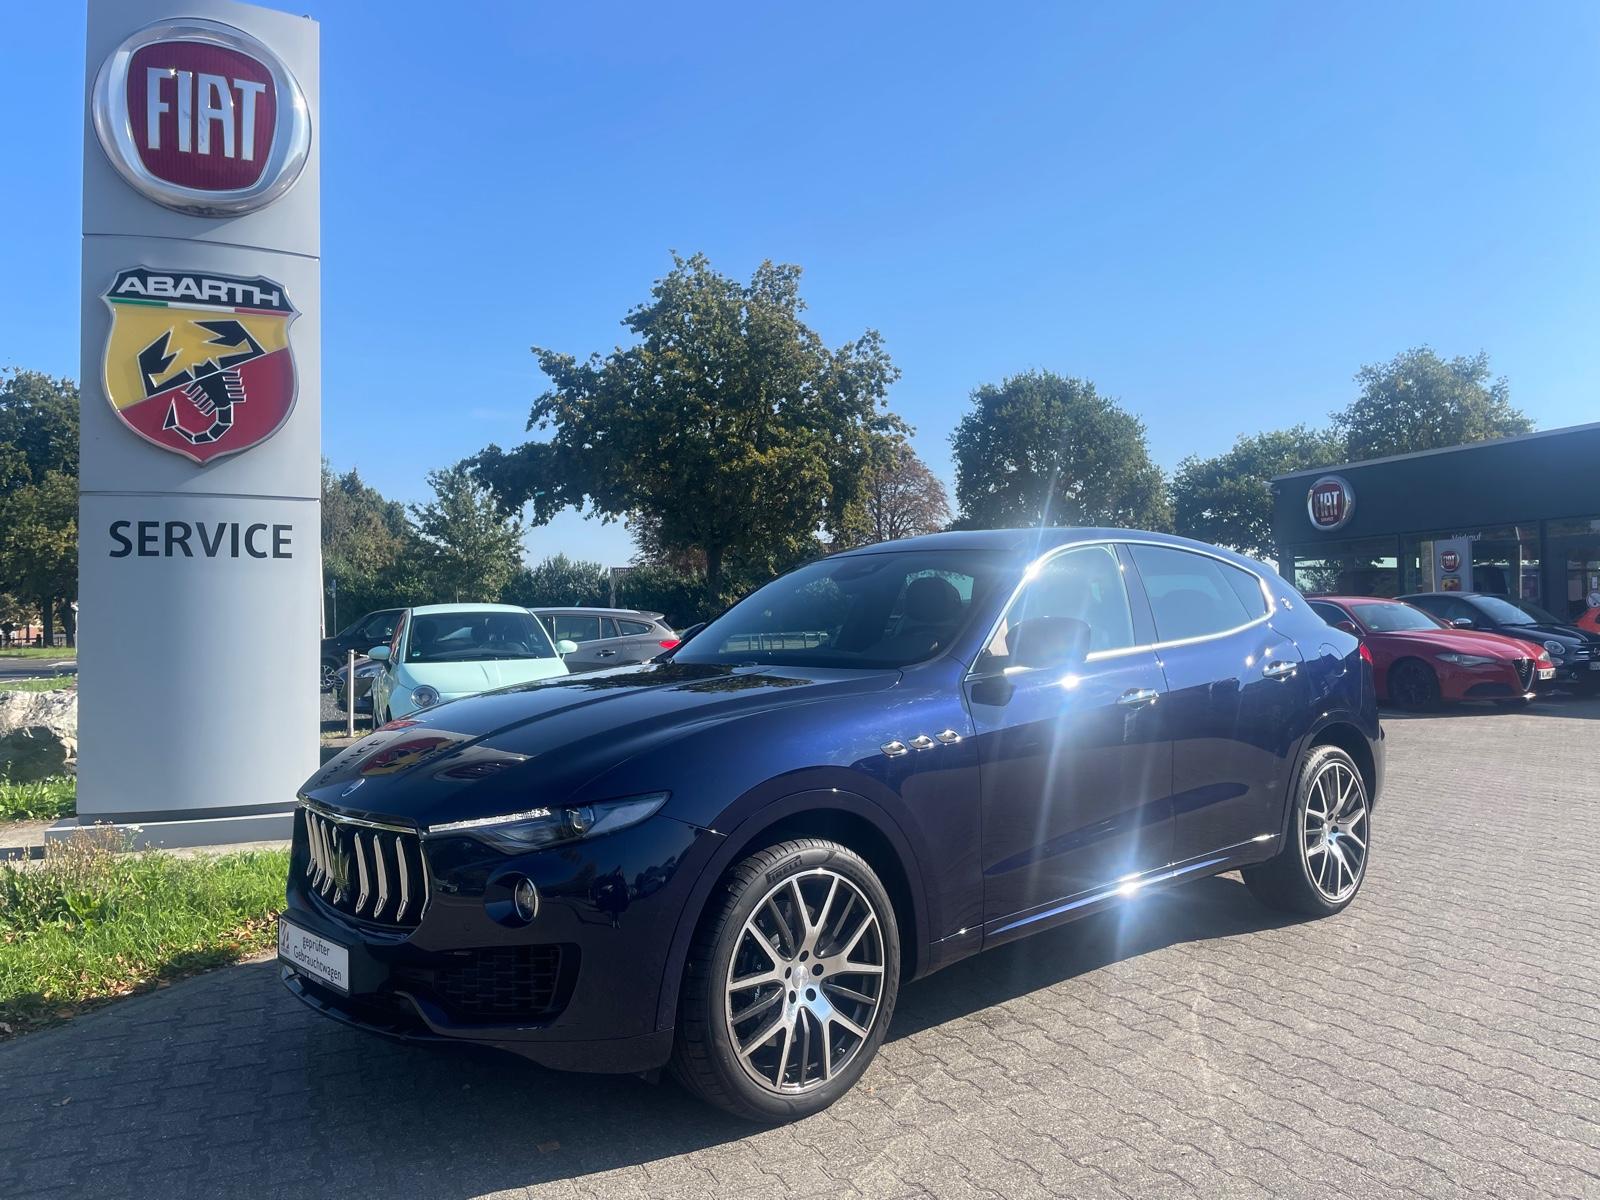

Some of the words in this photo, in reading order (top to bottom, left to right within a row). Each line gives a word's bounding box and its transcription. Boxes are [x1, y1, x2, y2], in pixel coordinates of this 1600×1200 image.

[146, 66, 266, 162] FIAT
[115, 276, 281, 307] ABARTH
[1314, 490, 1340, 518] FIAT
[108, 520, 293, 559] SERVICE
[302, 936, 331, 957] geprüfter
[293, 945, 342, 983] Gebrauchtwagen
